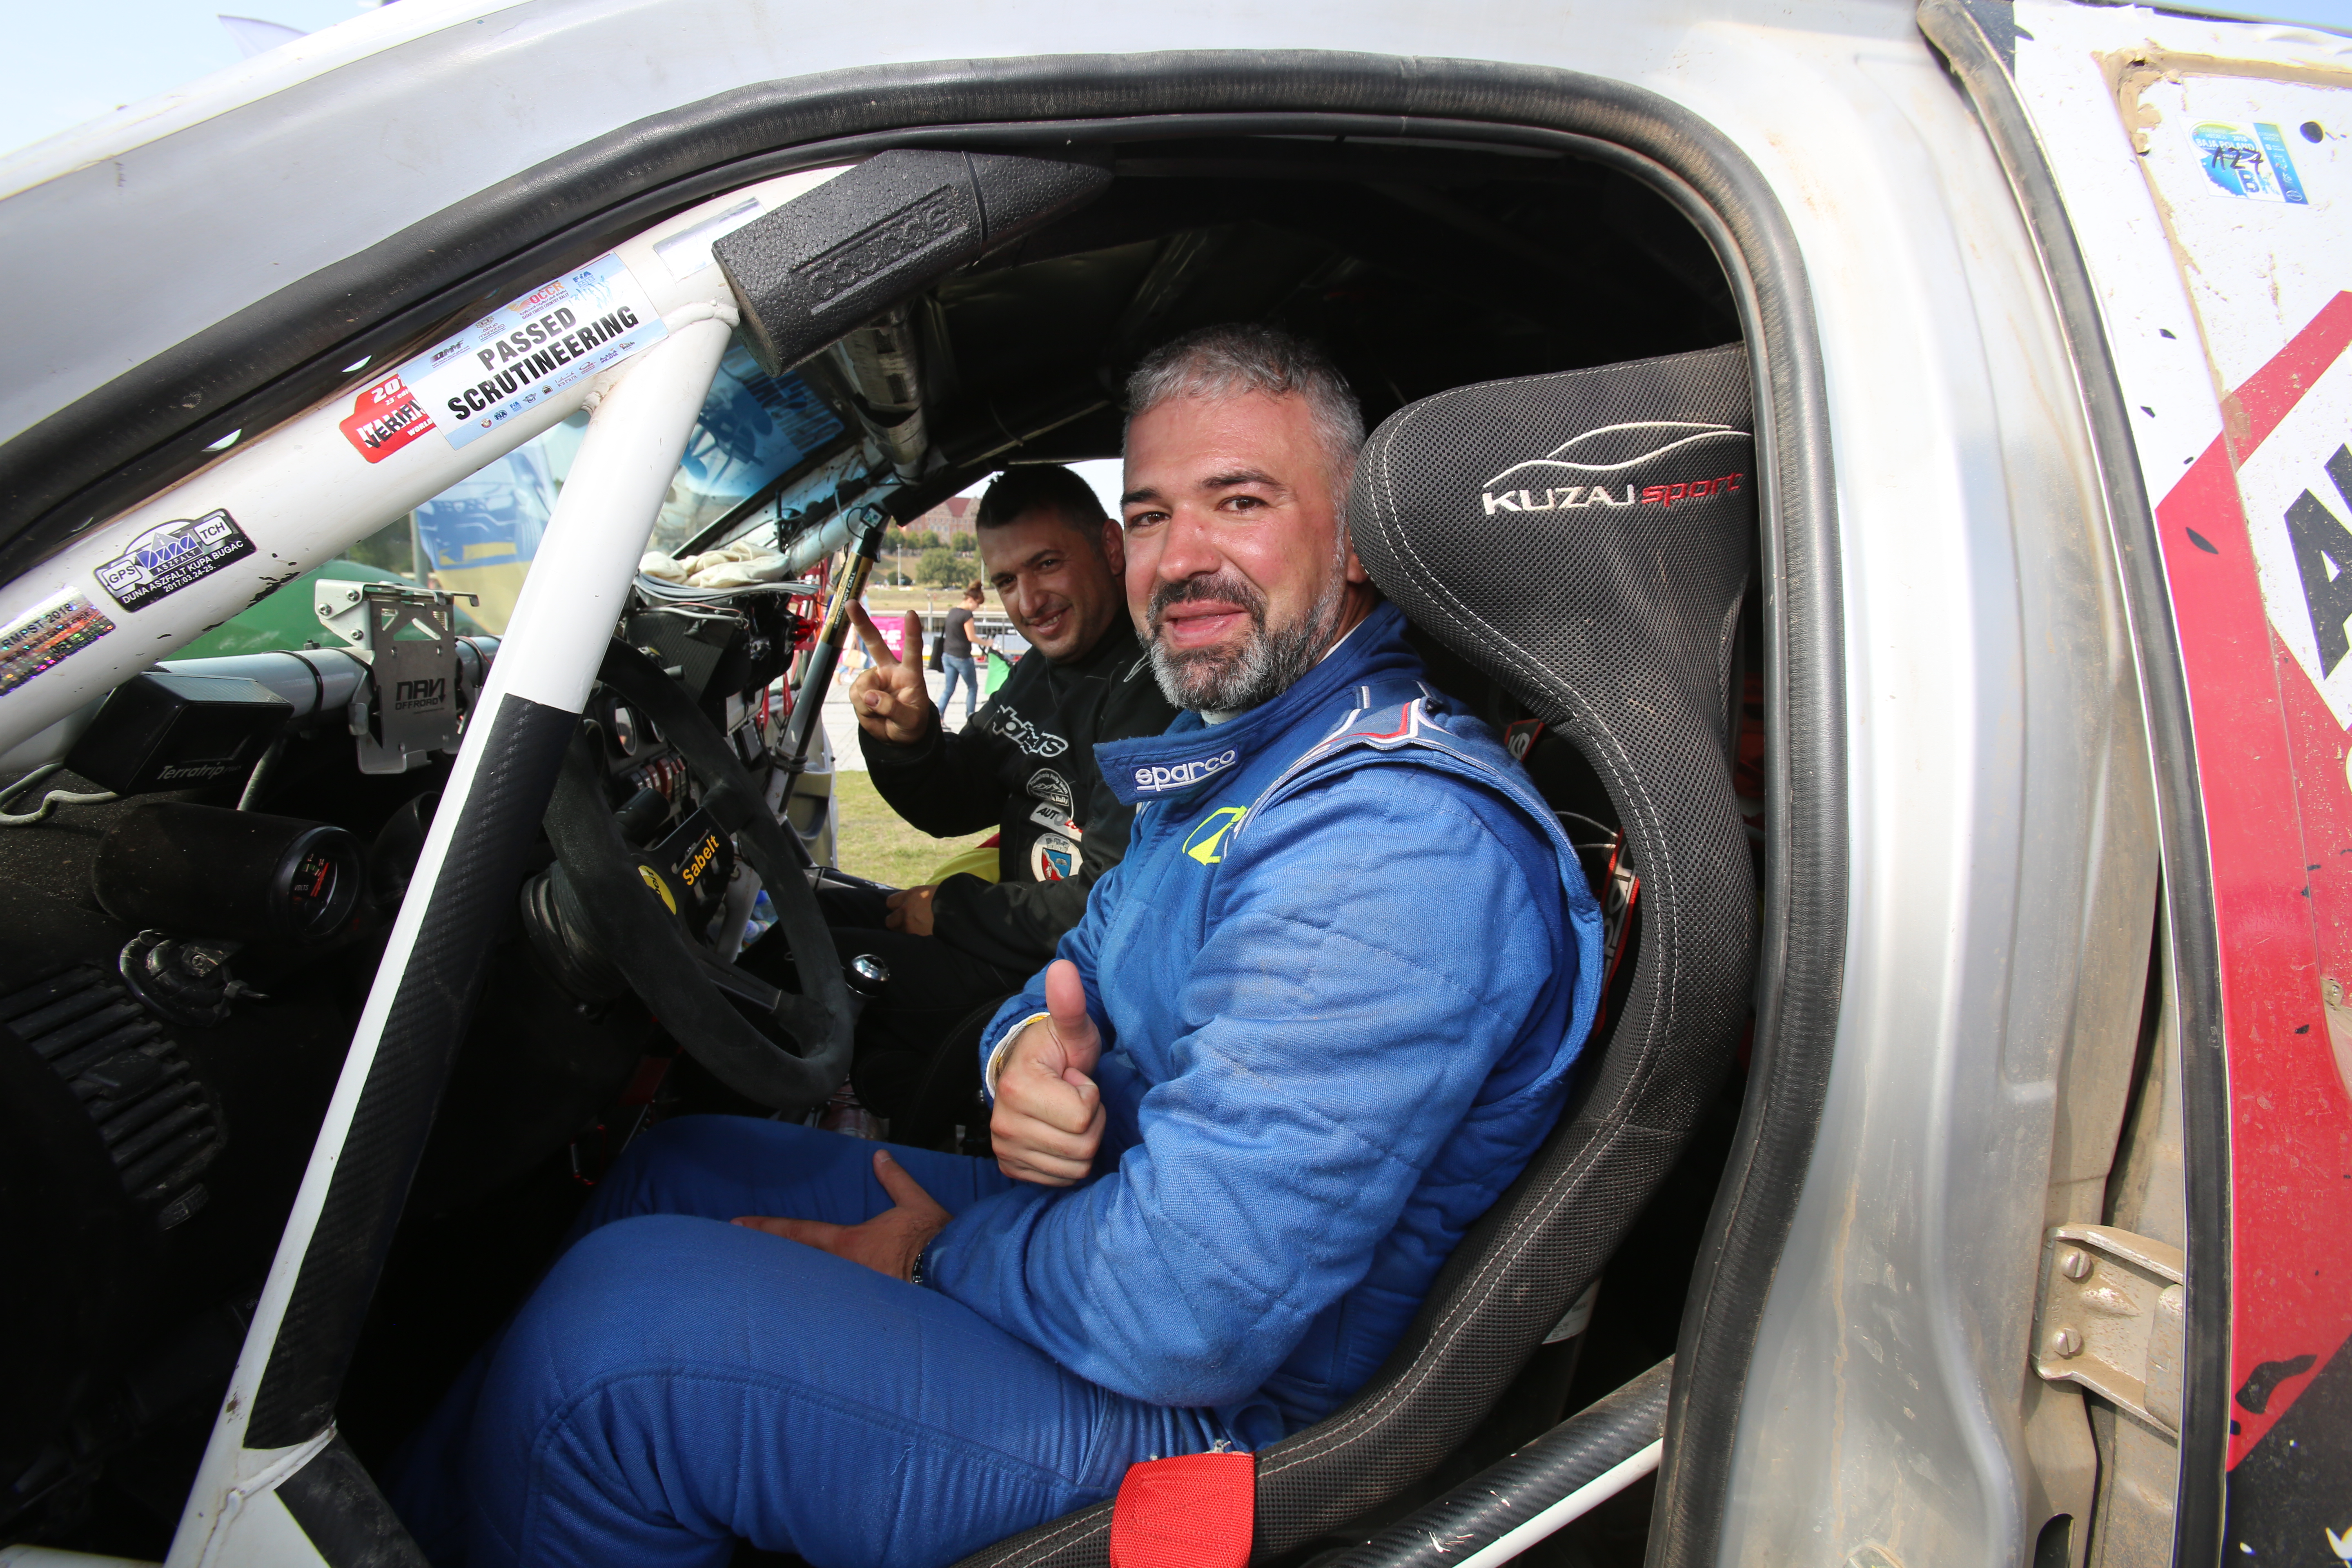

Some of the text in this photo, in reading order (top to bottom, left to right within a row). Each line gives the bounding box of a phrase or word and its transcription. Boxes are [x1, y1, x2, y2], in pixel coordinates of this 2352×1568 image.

[2195, 138, 2218, 148] BAJA
[2218, 140, 2256, 151] POLAND
[529, 281, 565, 304] QCCR
[532, 306, 544, 316] CROSS
[544, 298, 559, 308] COUNTRY
[559, 292, 570, 301] RALLY
[477, 306, 577, 371] PASSED
[447, 305, 639, 420] SCRUTINEERING
[601, 352, 619, 364] MILAHA
[557, 375, 578, 388] katara
[407, 418, 434, 437] WORLD
[1642, 472, 1744, 508] sport
[199, 522, 226, 542] TCH
[156, 550, 197, 572] ASZFALT
[109, 566, 136, 584] GPS
[122, 540, 245, 604] DUNA ASZFALT KUPA BUGAC
[163, 564, 217, 593] 2017.03.24-25.
[847, 571, 857, 588] CALL
[2, 603, 74, 647] RMPST 2018
[71, 610, 91, 626] cage
[395, 698, 438, 710] OFFROAD
[156, 762, 225, 780] Terratrip
[1135, 749, 1236, 792] sparco
[1050, 773, 1060, 784] Rally
[1059, 781, 1069, 794] Team
[1056, 795, 1069, 804] Rally
[318, 858, 325, 866] 14
[682, 834, 720, 886] Sabelt
